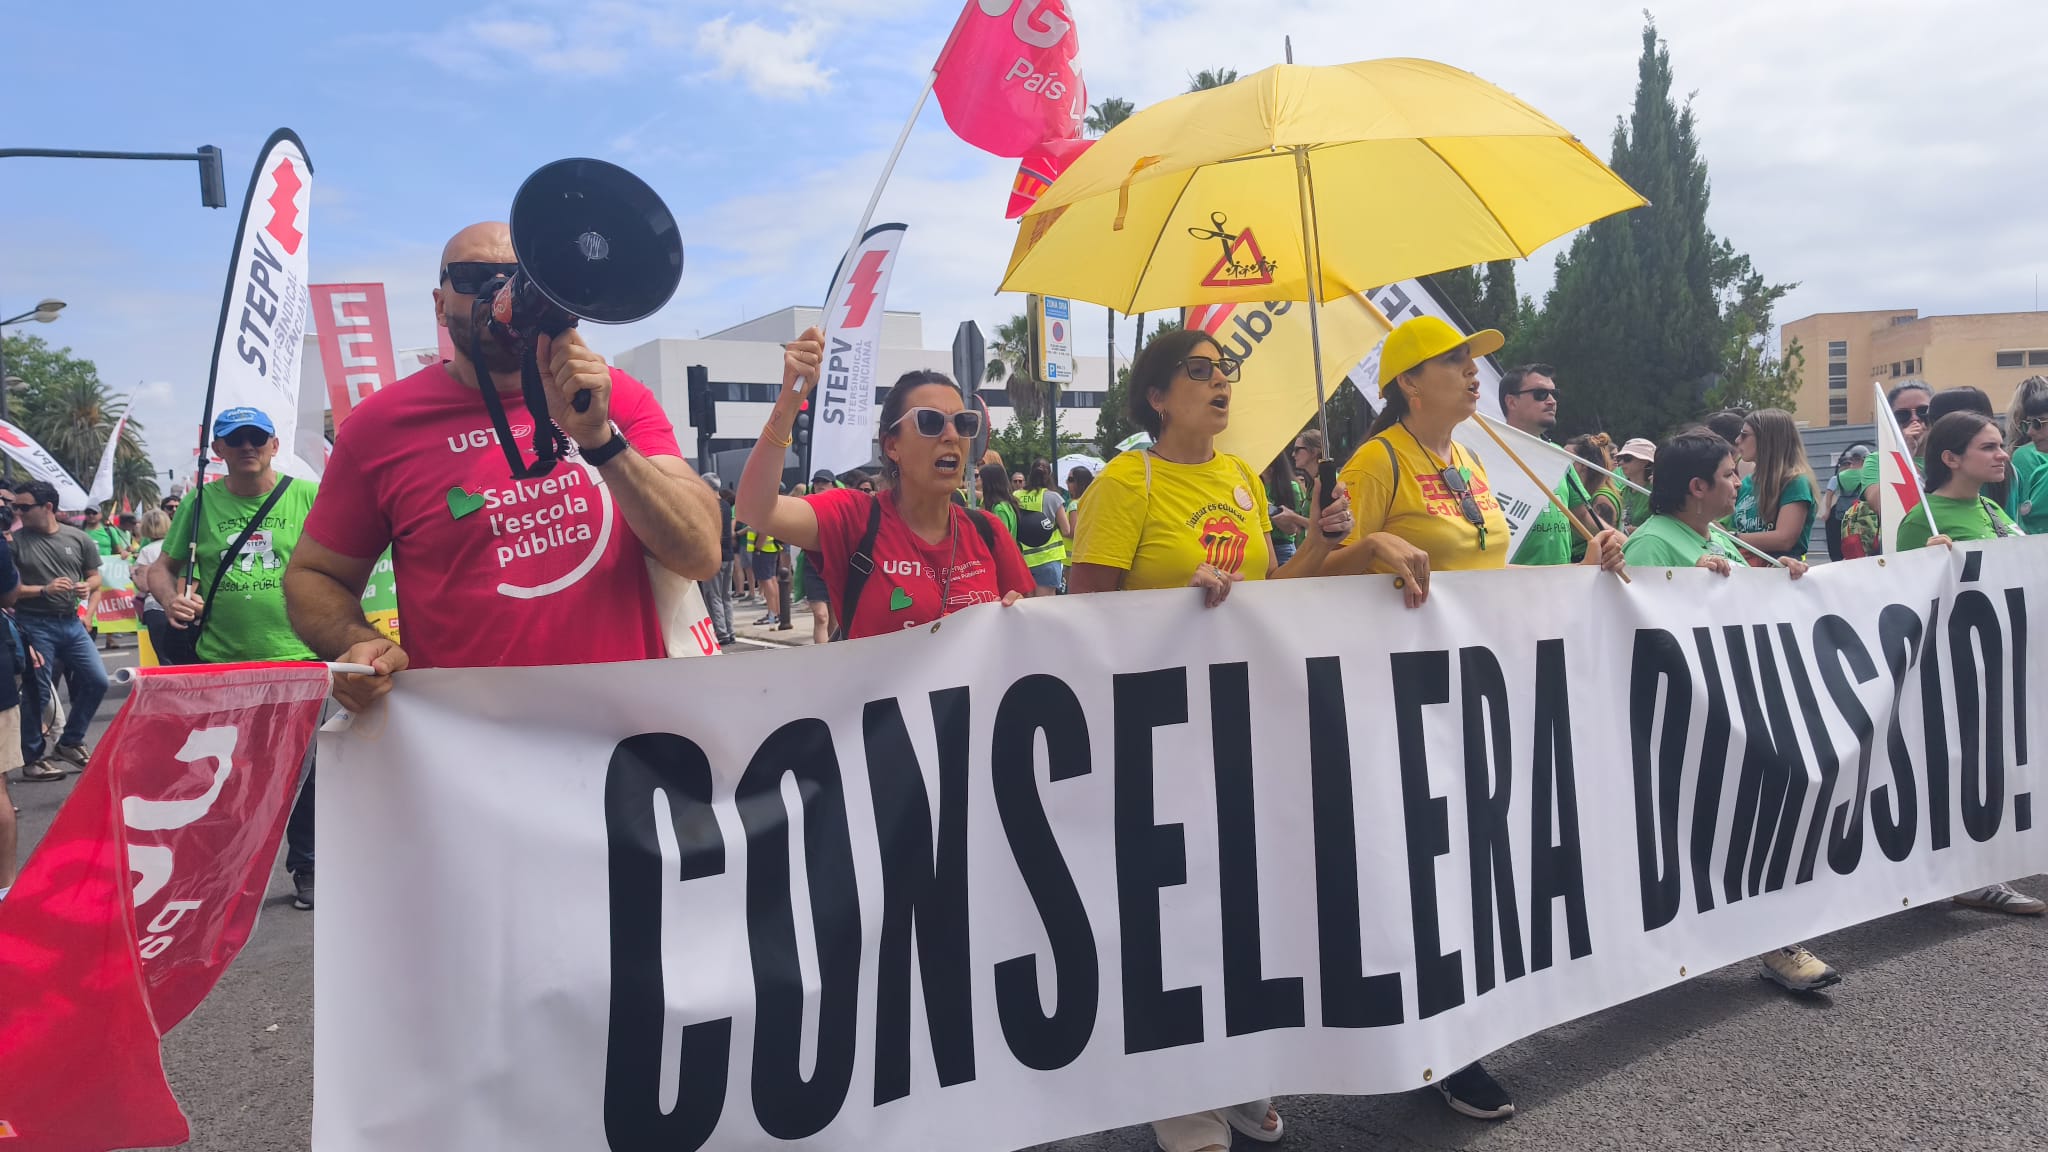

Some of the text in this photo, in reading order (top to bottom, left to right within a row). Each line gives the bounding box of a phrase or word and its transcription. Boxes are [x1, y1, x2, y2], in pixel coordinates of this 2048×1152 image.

[1004, 56, 1066, 100] País
[237, 231, 283, 377] STEPV
[330, 292, 382, 409] CCO
[822, 336, 853, 425] STEPV
[848, 339, 863, 426] INTERSINDICAL
[859, 340, 873, 412] VALENCIANA
[482, 470, 581, 509] Salvem
[489, 494, 588, 536] l'escola
[497, 523, 592, 568] pública
[604, 638, 1592, 1152] CONSELLERA
[1629, 550, 2031, 932] DIMISSIÓ!
